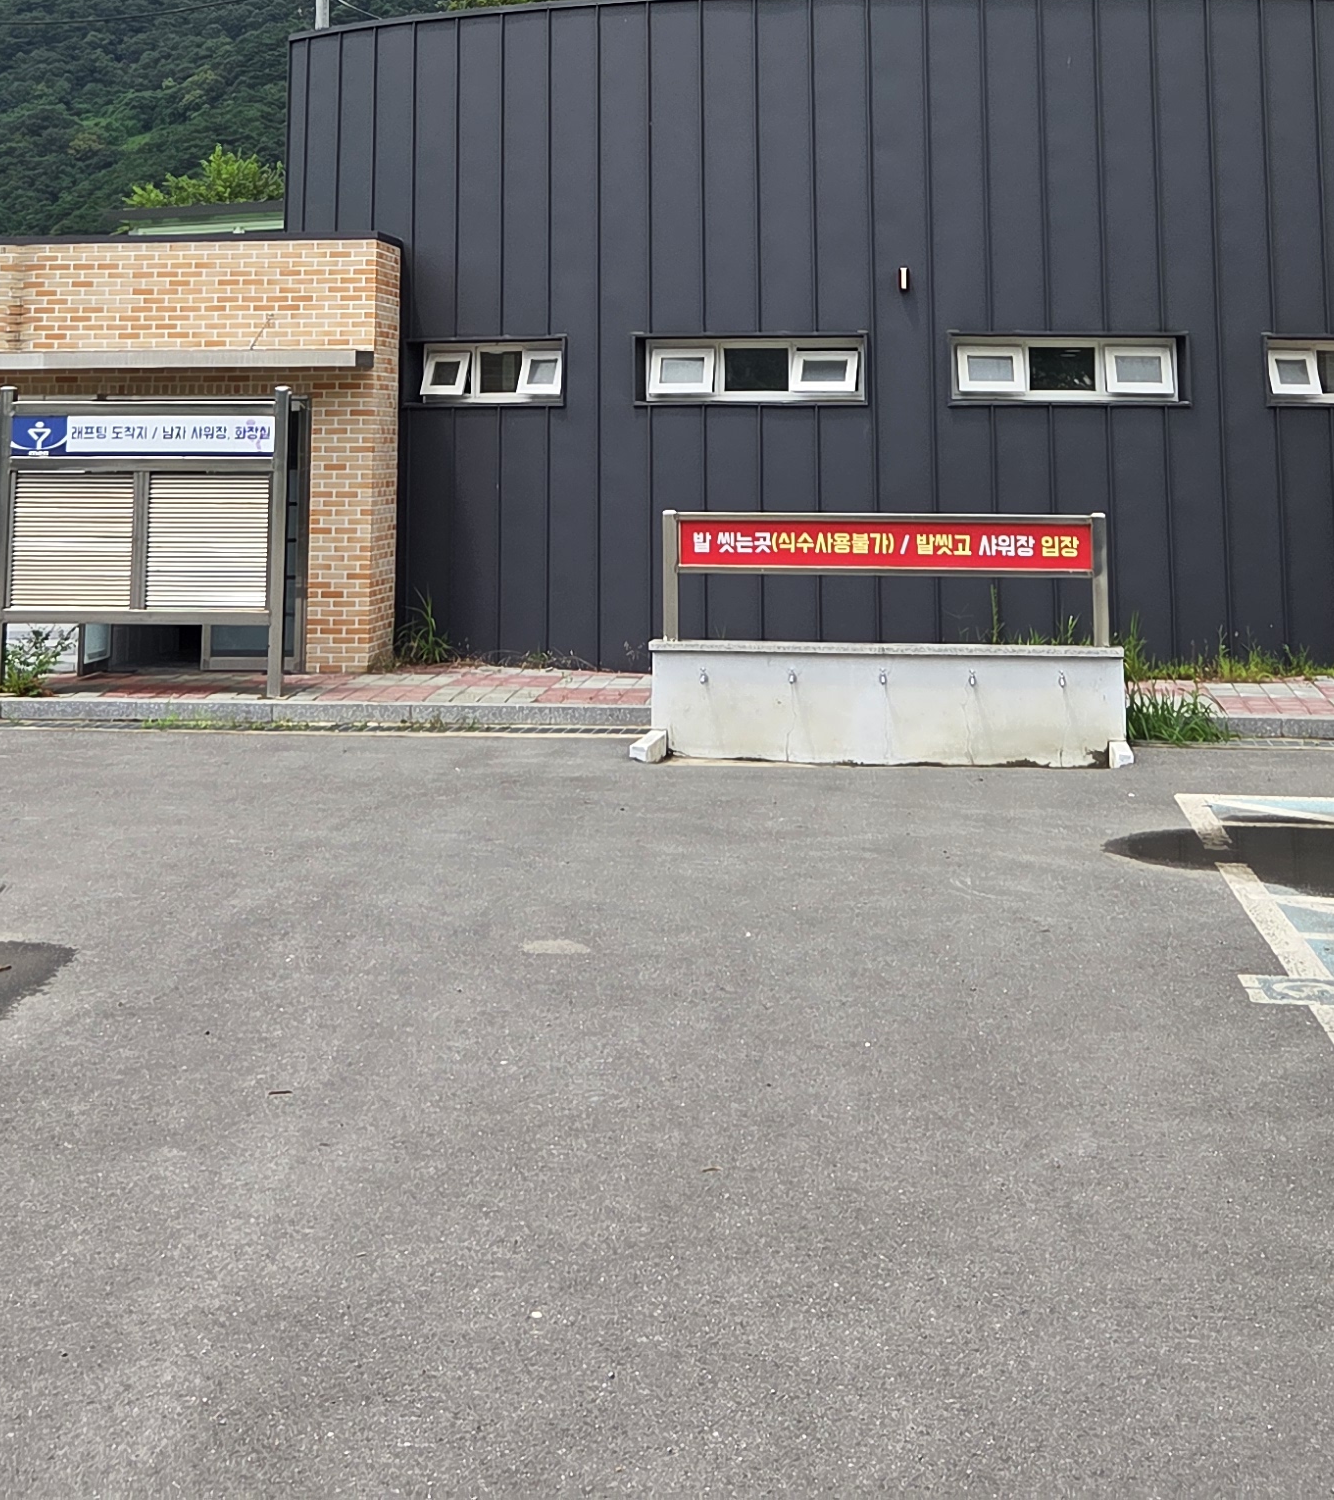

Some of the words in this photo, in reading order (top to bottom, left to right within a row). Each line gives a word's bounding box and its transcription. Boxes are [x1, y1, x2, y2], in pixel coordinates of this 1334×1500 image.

[71, 426, 107, 439] 래프팅
[111, 426, 147, 439] 도착지
[162, 426, 186, 439] 남자
[234, 426, 271, 440] 화장실
[693, 532, 711, 553] 발
[916, 533, 972, 556] 발씻고
[978, 534, 1035, 557] 샤워장
[1041, 535, 1079, 558] 입장
